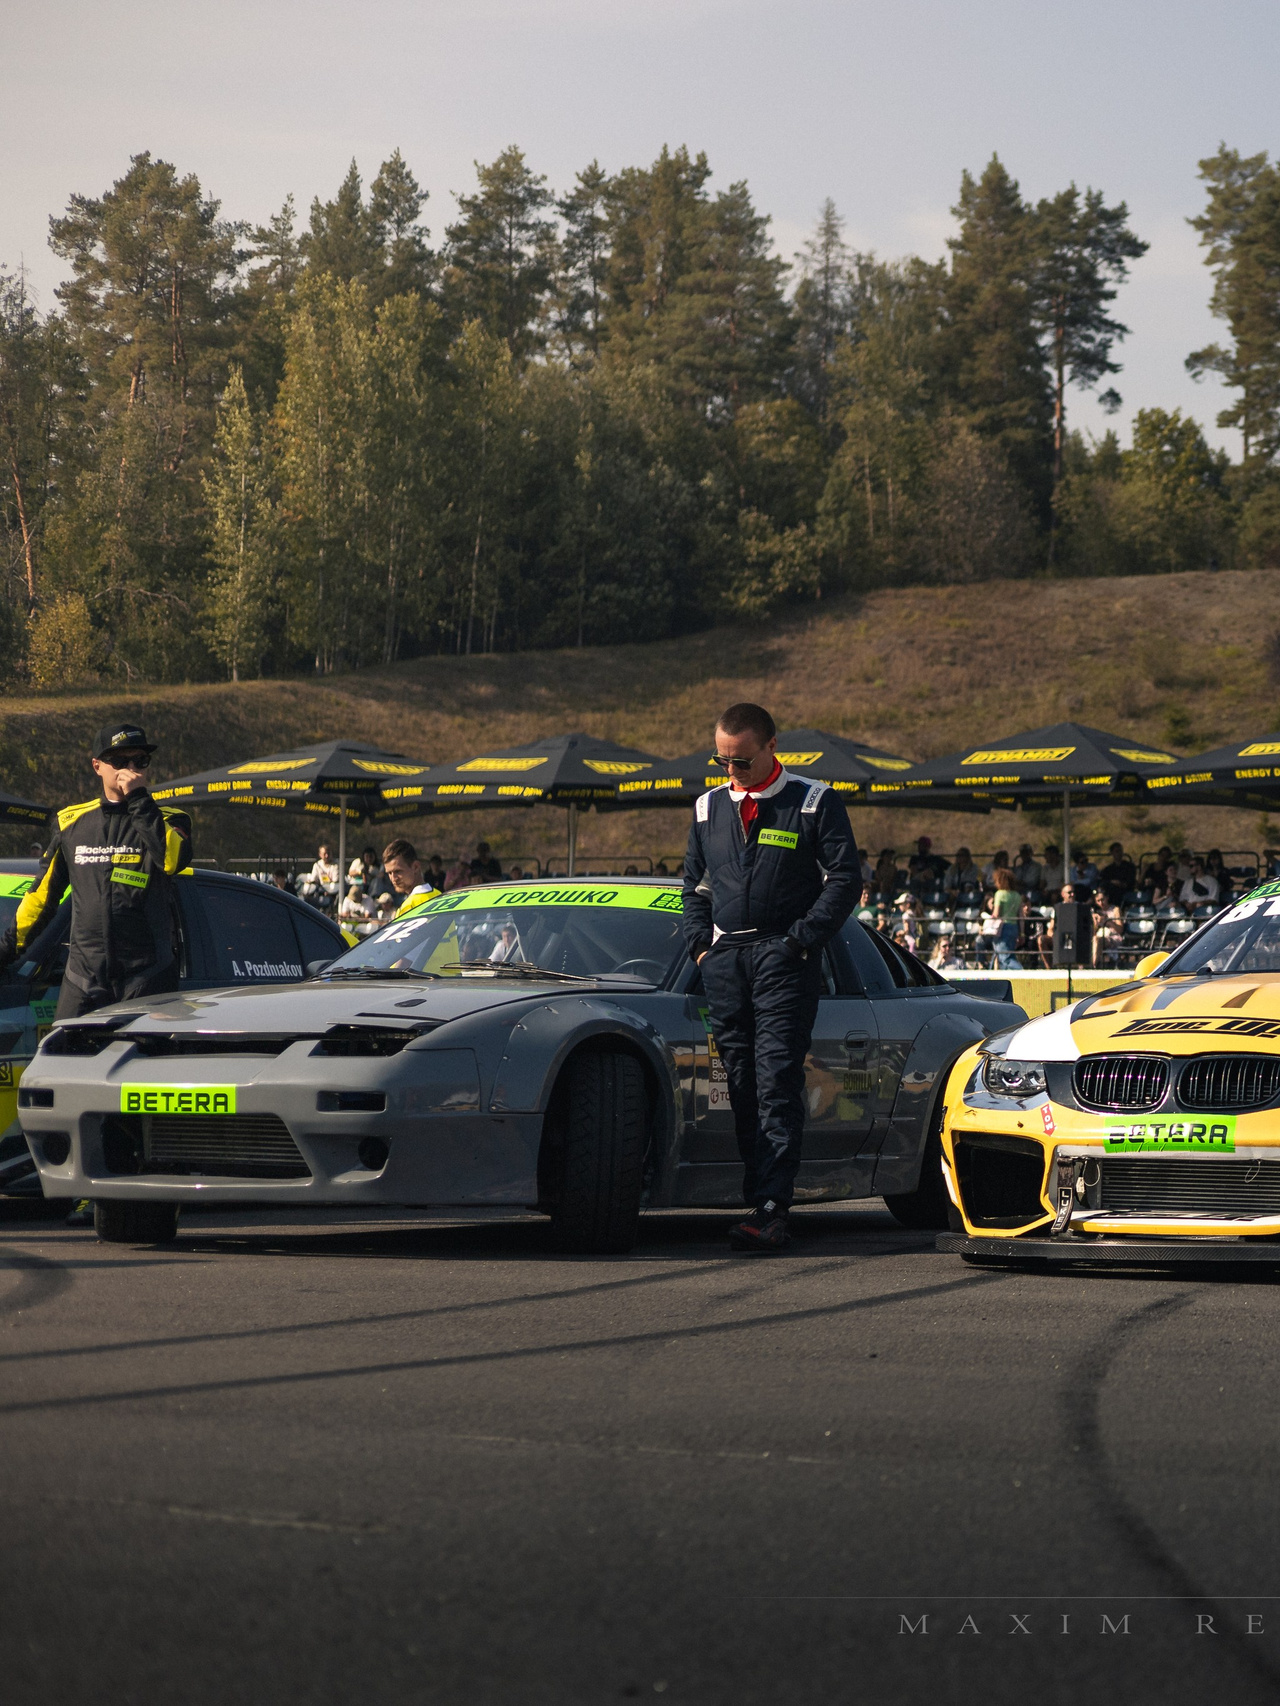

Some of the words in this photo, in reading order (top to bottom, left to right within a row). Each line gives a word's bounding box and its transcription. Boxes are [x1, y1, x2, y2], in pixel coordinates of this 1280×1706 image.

[1083, 776, 1112, 786] DRINK
[1147, 776, 1183, 789] ENERGY
[1185, 772, 1213, 783] DRINK
[1235, 769, 1271, 779] ENERGY
[208, 781, 231, 793] ENERGY
[232, 780, 252, 791] DRINK
[619, 780, 652, 793] ENERGY
[655, 778, 683, 789] DRINK
[954, 777, 990, 787] ENERGY
[991, 776, 1020, 785] DRINK
[75, 844, 134, 855] Blockchain
[74, 855, 110, 865] Sports
[493, 890, 619, 905] ГОРОШКО
[374, 917, 429, 943] 12
[232, 960, 245, 976] A.
[246, 960, 303, 977] Pozdniakov
[1042, 1105, 1054, 1131] TOW
